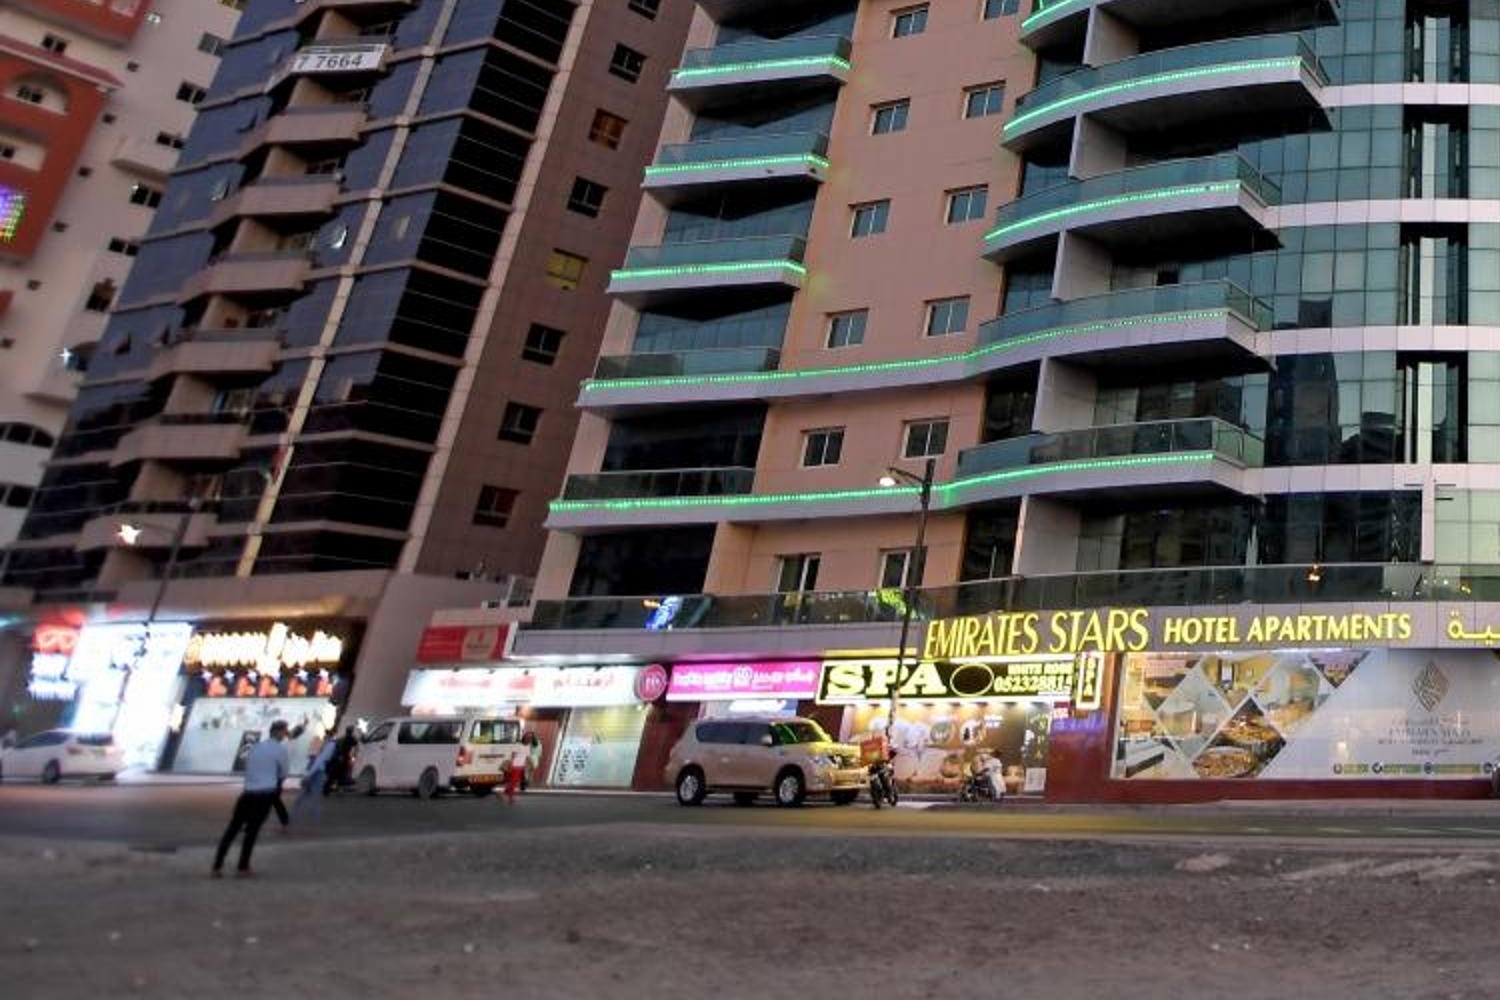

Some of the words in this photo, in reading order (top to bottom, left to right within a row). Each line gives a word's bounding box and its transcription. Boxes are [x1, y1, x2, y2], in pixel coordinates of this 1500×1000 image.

[924, 610, 1039, 659] EMIRATES
[1049, 609, 1149, 654] STARS
[1164, 616, 1241, 645] HOTEL
[1247, 613, 1411, 642] APARTMENTS
[827, 661, 948, 697] SPA
